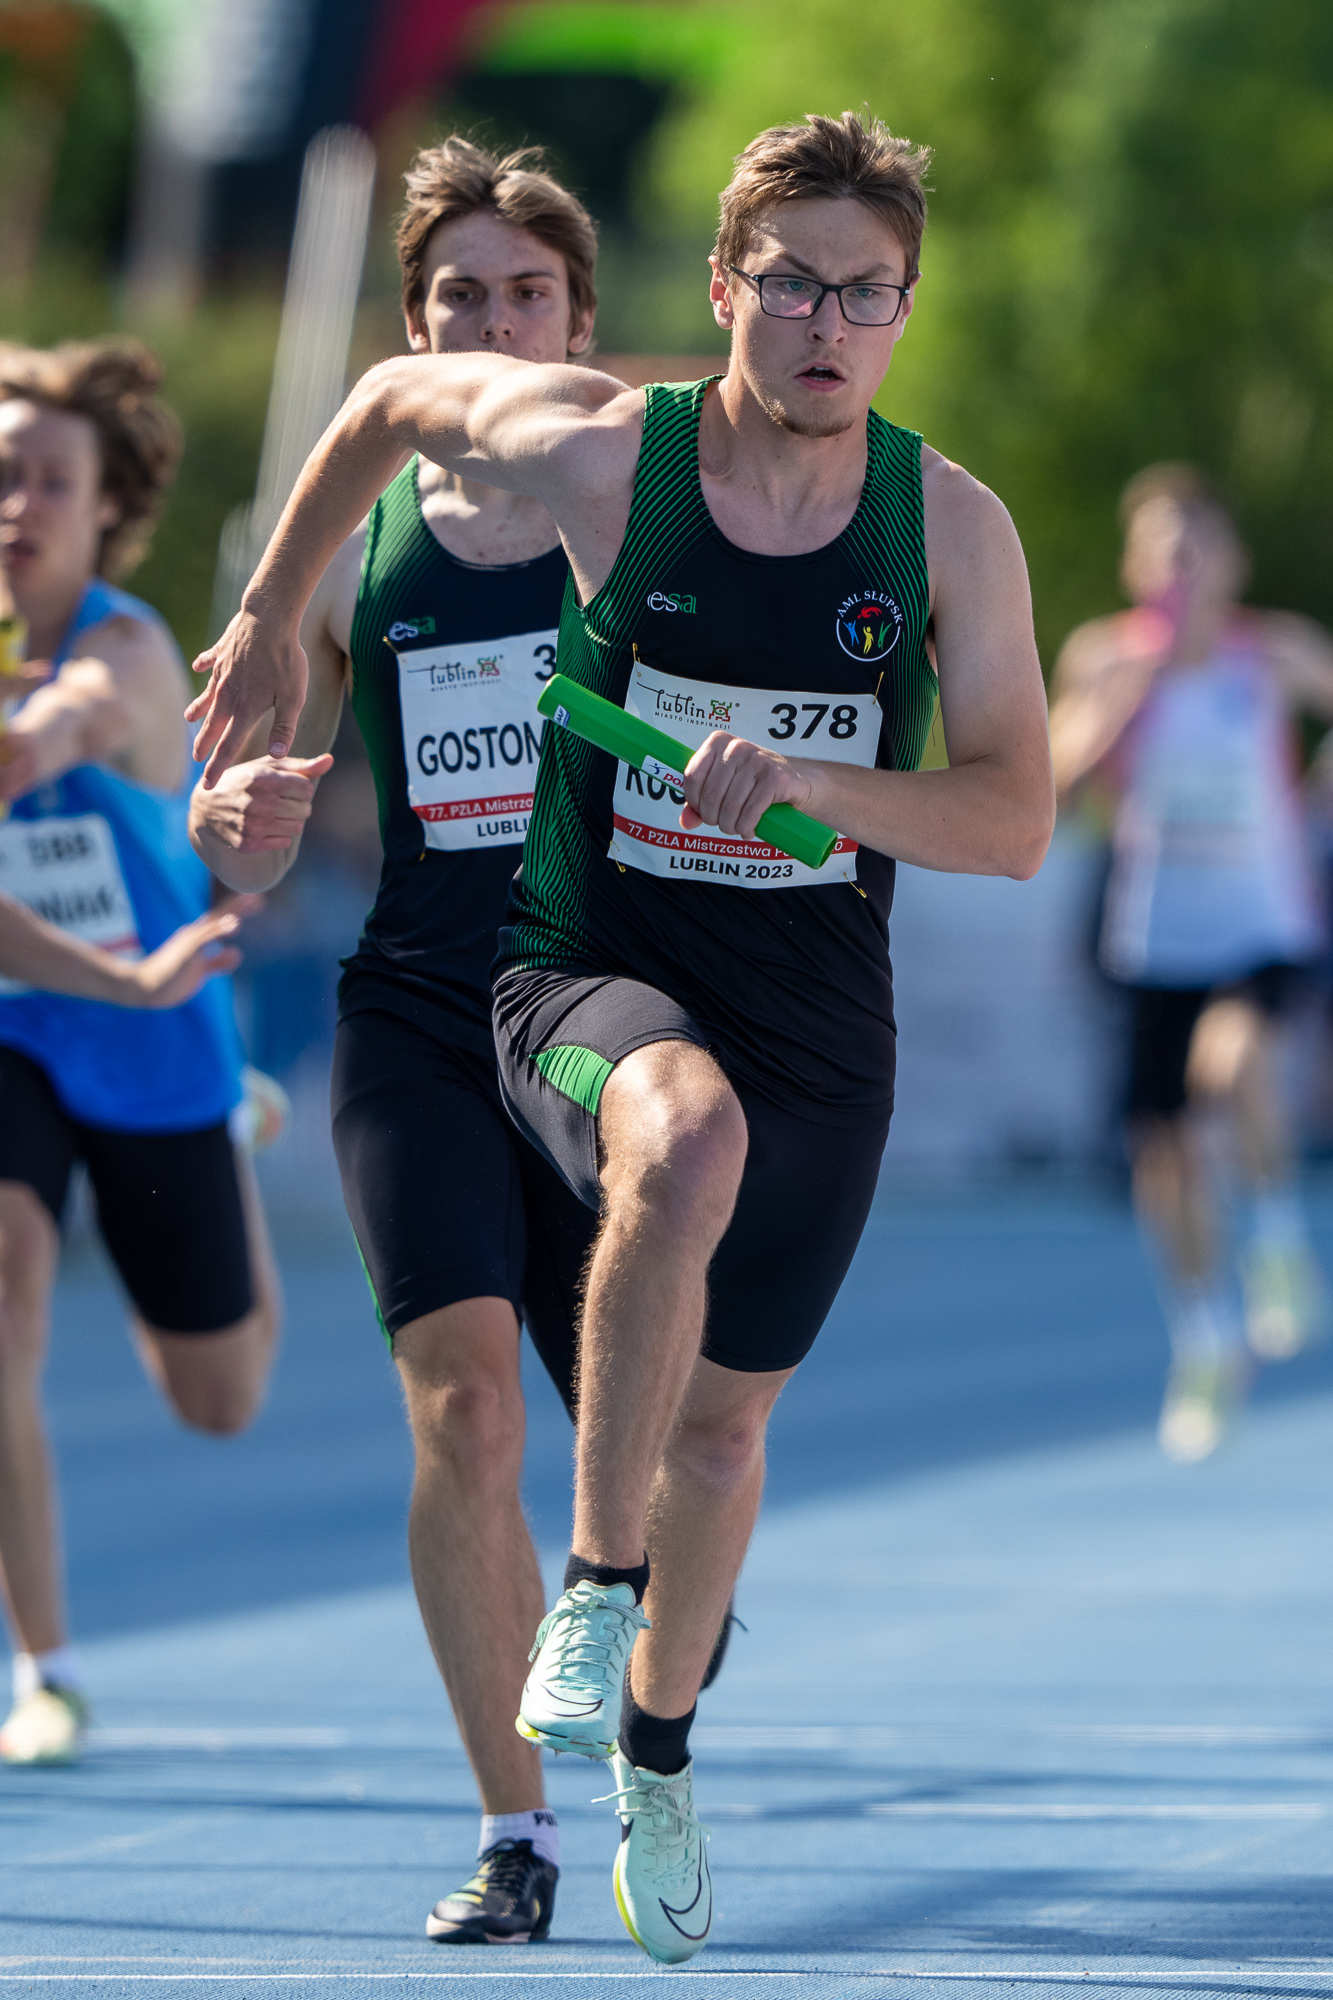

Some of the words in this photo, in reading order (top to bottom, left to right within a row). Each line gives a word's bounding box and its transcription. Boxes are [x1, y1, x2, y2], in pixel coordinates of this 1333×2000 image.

[837, 593, 862, 618] AML
[863, 590, 904, 624] SŁUPSK
[654, 711, 683, 722] MIASTO
[686, 718, 731, 730] INSPIRACJI
[768, 703, 859, 740] 378
[428, 806, 448, 819] 77.
[450, 803, 483, 817] PZLA
[477, 817, 532, 838] LUBLI
[628, 822, 645, 839] 77.
[648, 830, 680, 848] PZLA
[683, 838, 771, 857] Mistrzostwa
[669, 855, 740, 878] LUBLIN
[745, 864, 793, 879] 2023
